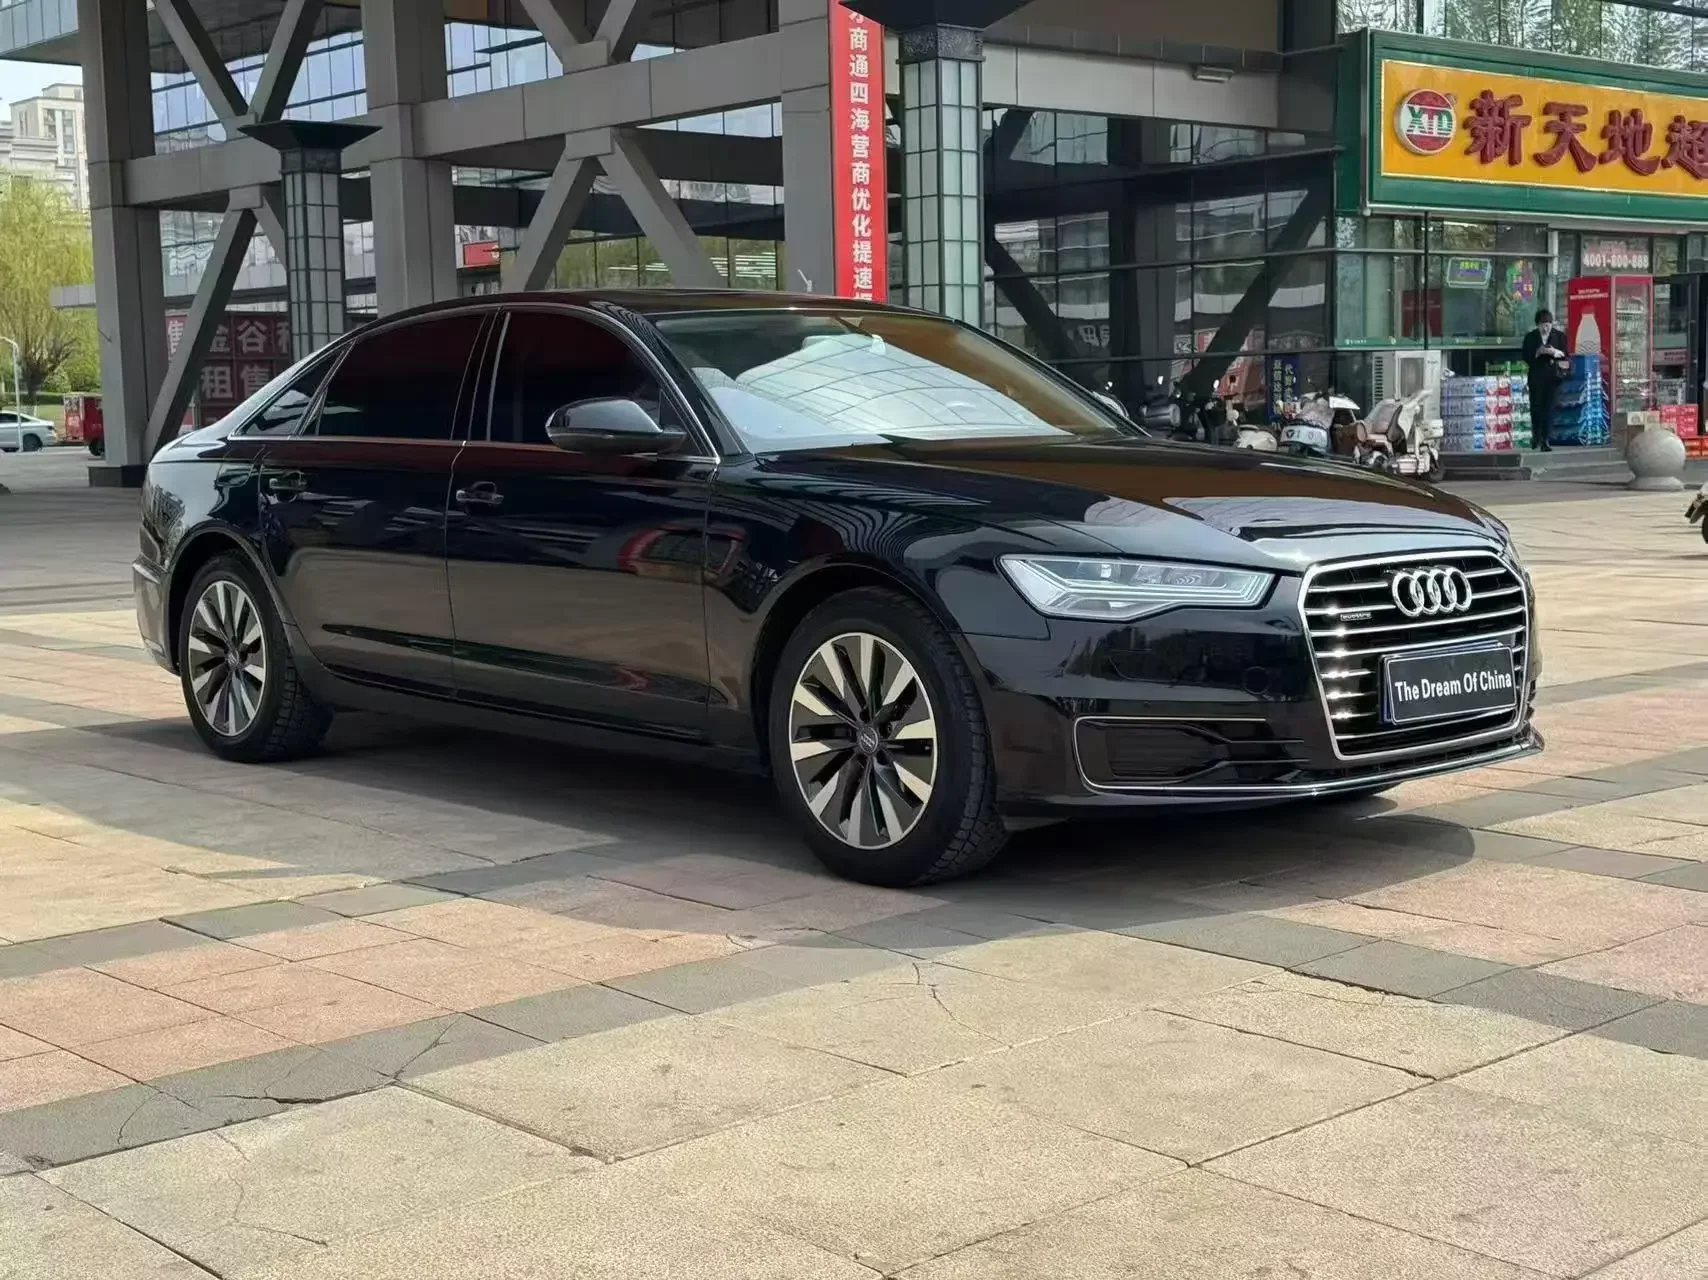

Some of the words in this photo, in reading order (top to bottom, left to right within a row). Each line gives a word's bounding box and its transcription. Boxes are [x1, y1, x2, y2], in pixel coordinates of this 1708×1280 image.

[1407, 105, 1453, 136] XTD
[1463, 89, 1708, 181] 新天地超
[1395, 681, 1419, 701] The
[1421, 678, 1461, 698] Dream
[1463, 672, 1478, 693] Of
[1479, 669, 1512, 691] China
